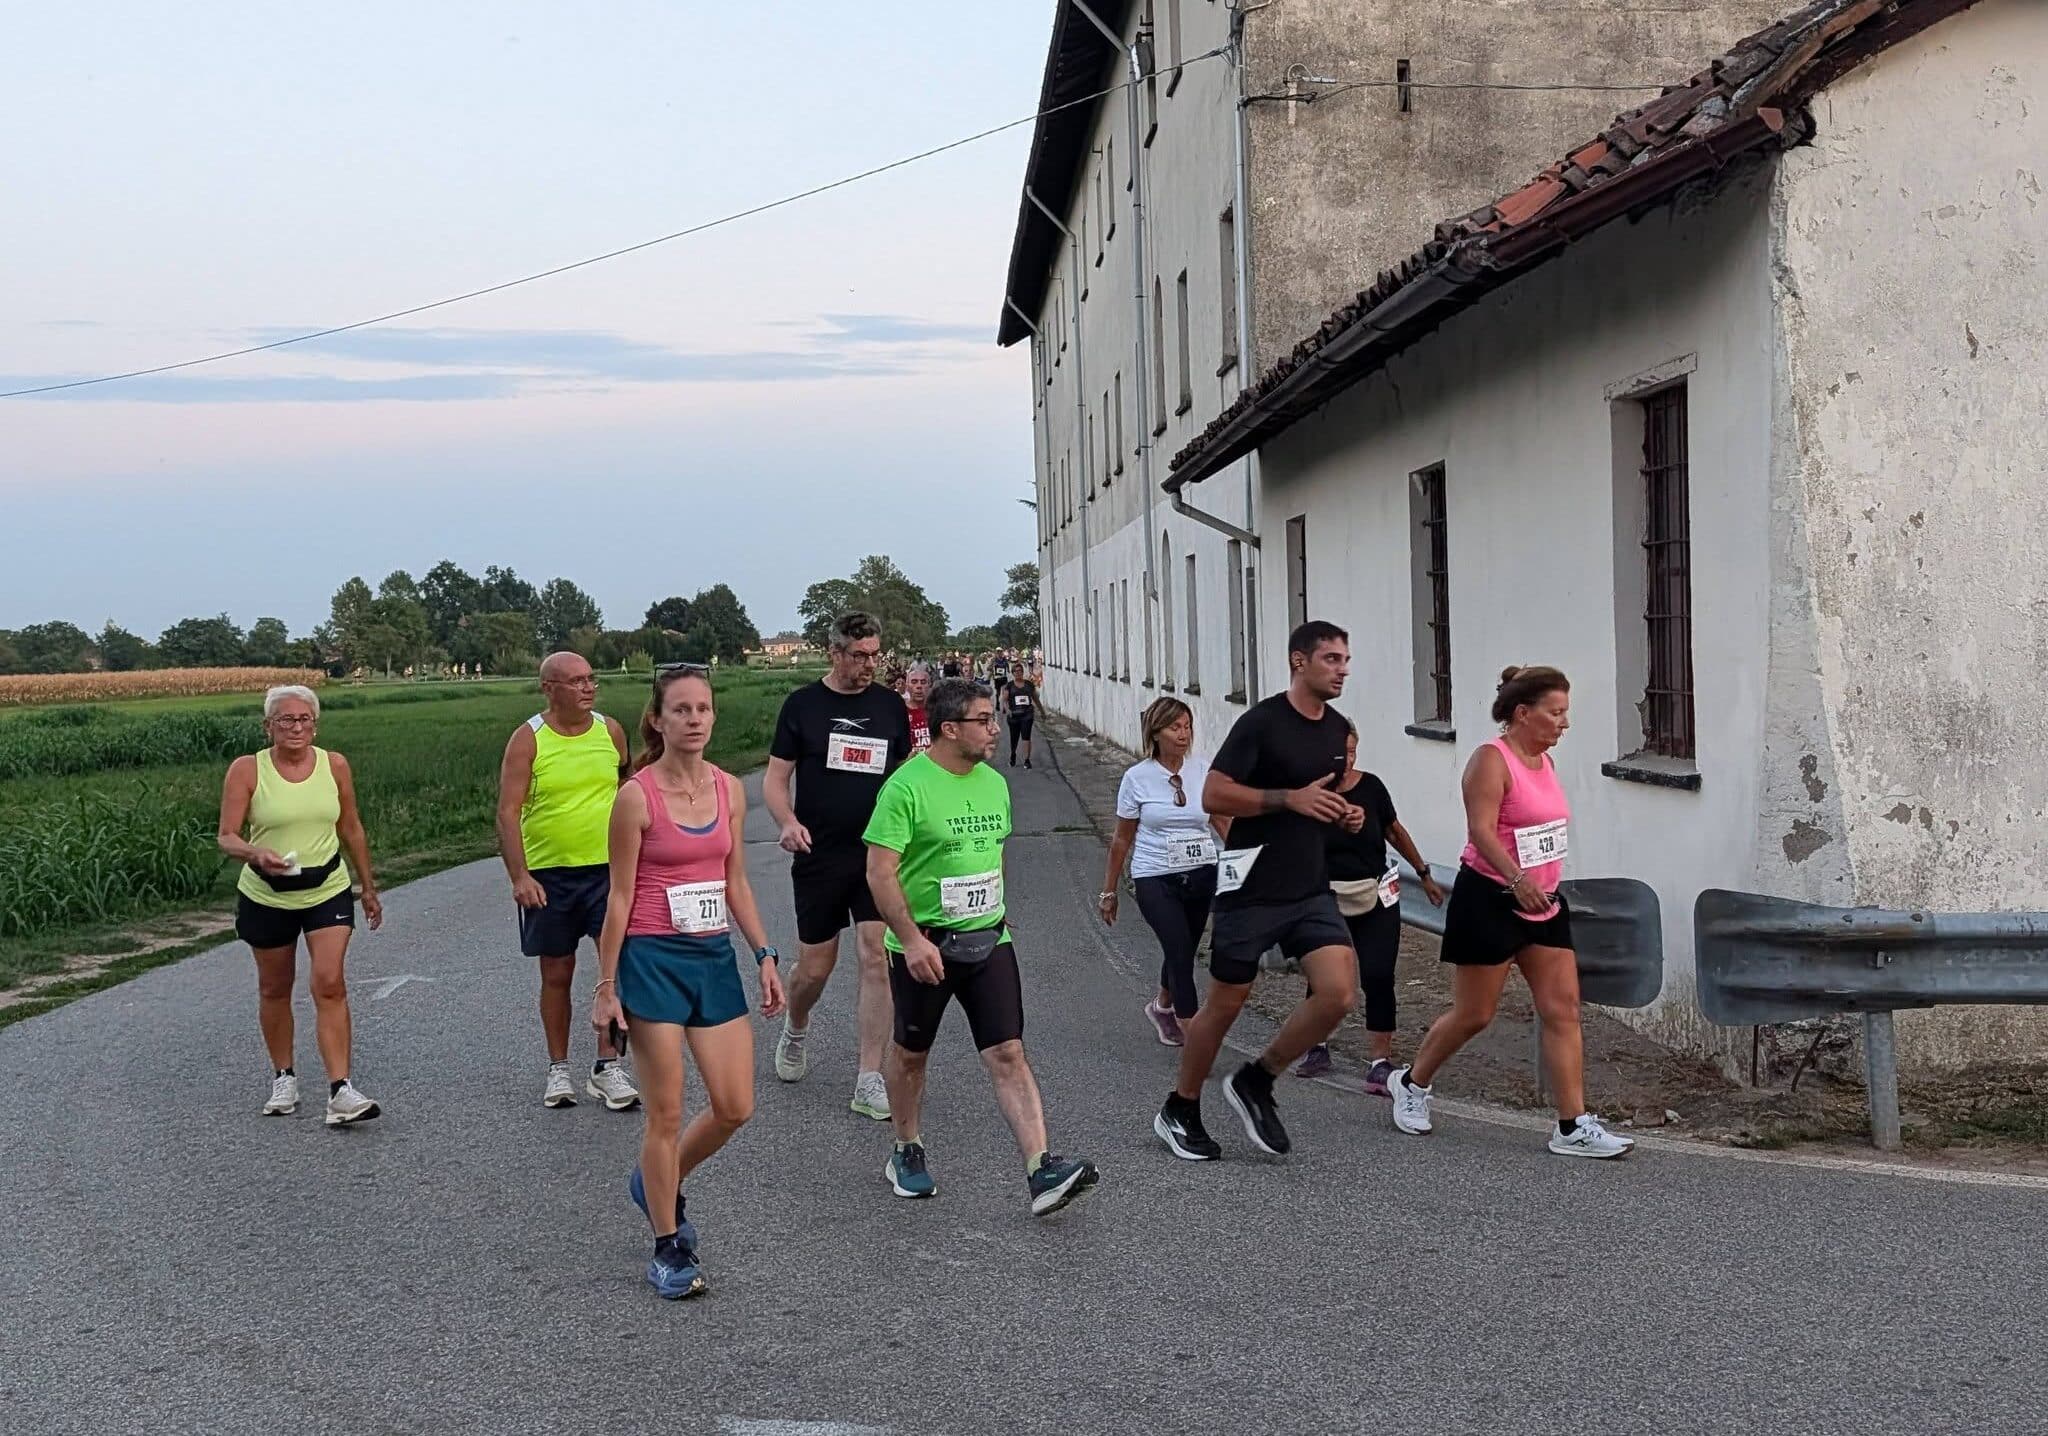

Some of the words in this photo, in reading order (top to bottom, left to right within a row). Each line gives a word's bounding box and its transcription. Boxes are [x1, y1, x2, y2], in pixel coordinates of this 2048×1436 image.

[848, 747, 866, 763] 524
[946, 814, 1002, 826] TREZZANO
[952, 826, 964, 835] IN
[967, 822, 1002, 833] CORSA
[968, 888, 987, 908] 272
[699, 898, 718, 919] 271
